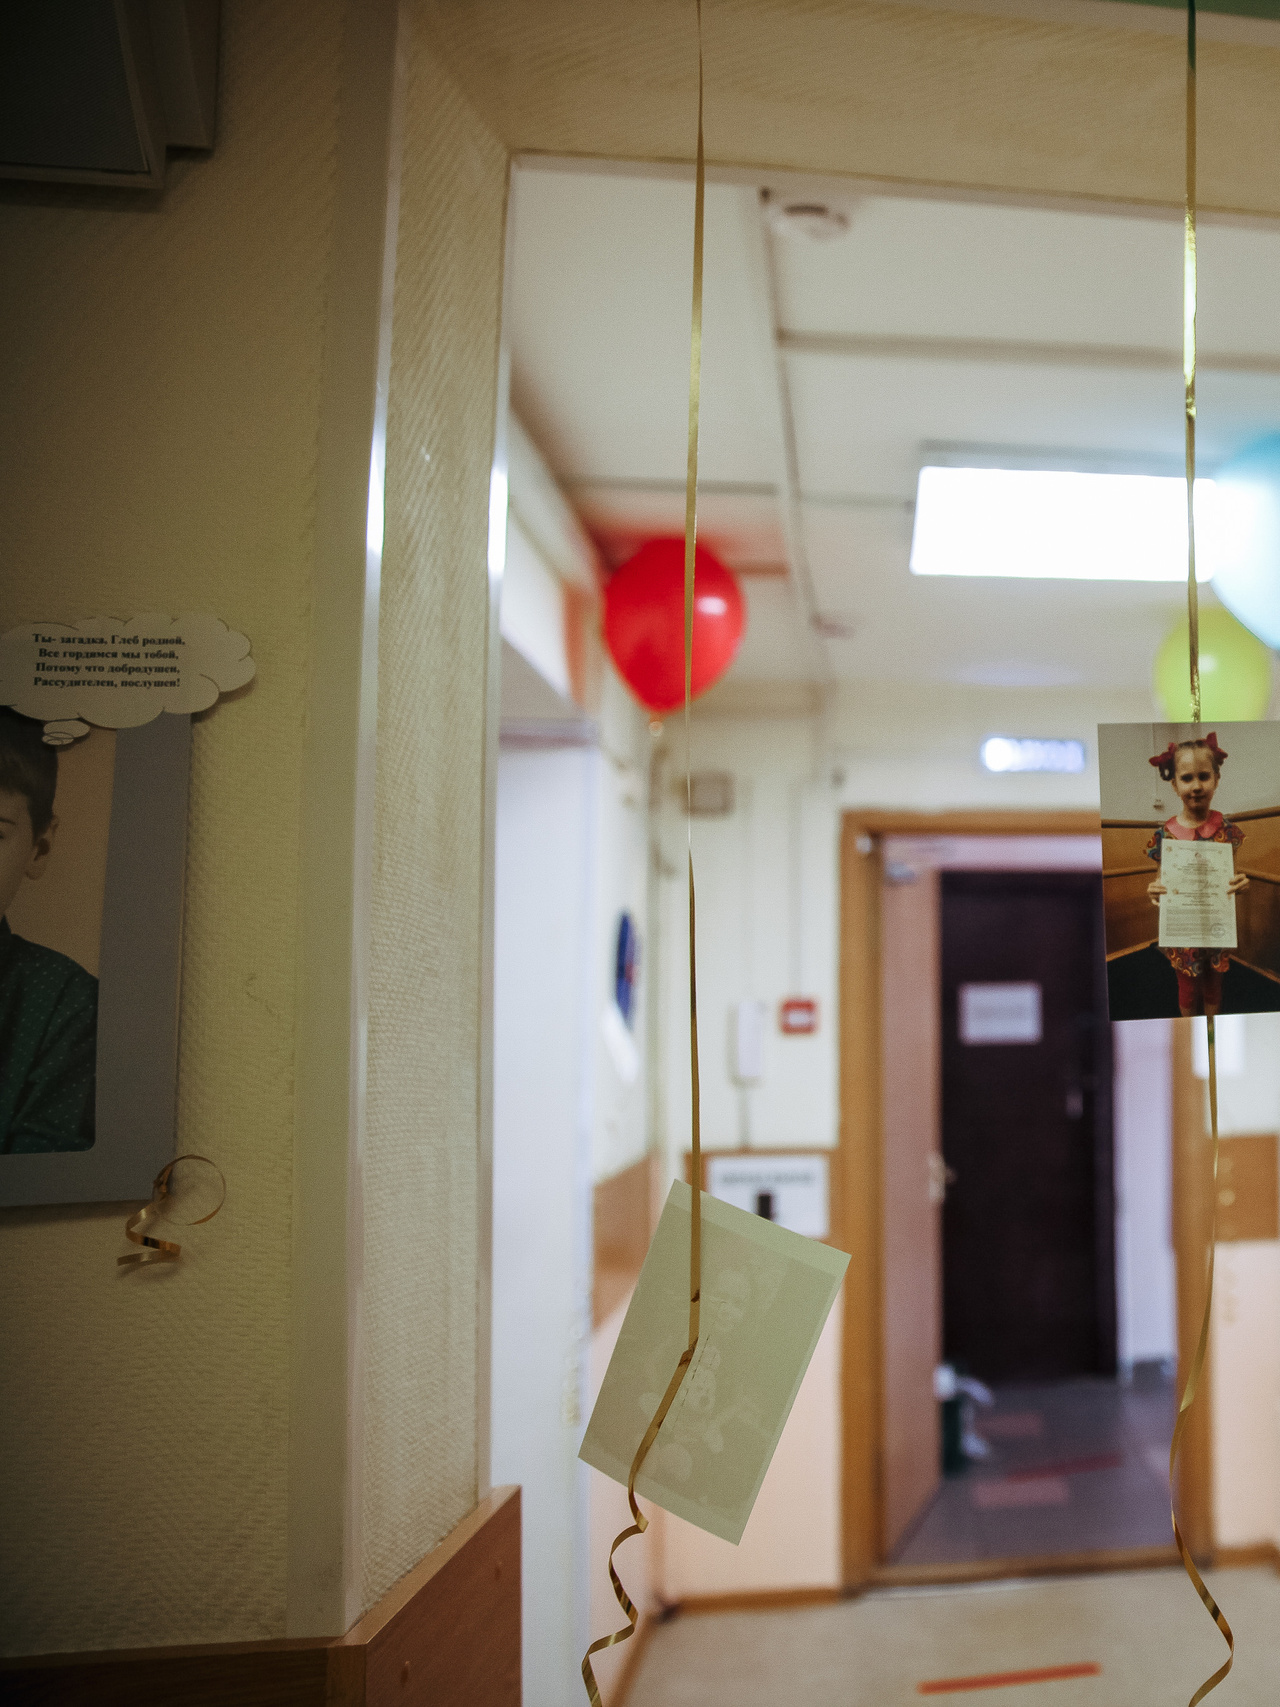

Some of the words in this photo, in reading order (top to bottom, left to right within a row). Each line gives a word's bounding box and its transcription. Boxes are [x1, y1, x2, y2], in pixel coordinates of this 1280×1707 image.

[32, 633, 57, 643] Ты-
[60, 636, 108, 645] загадка,
[111, 634, 139, 645] Глеб
[142, 635, 185, 647] родной,
[39, 648, 59, 658] Все
[63, 650, 118, 660] гордимся
[121, 651, 140, 659] мы
[144, 650, 179, 660] тобой,
[35, 662, 81, 674] Потому
[85, 664, 105, 672] что
[107, 663, 180, 675] добродушен,
[33, 677, 118, 688] Рассудителен,
[120, 678, 181, 689] послушен!
